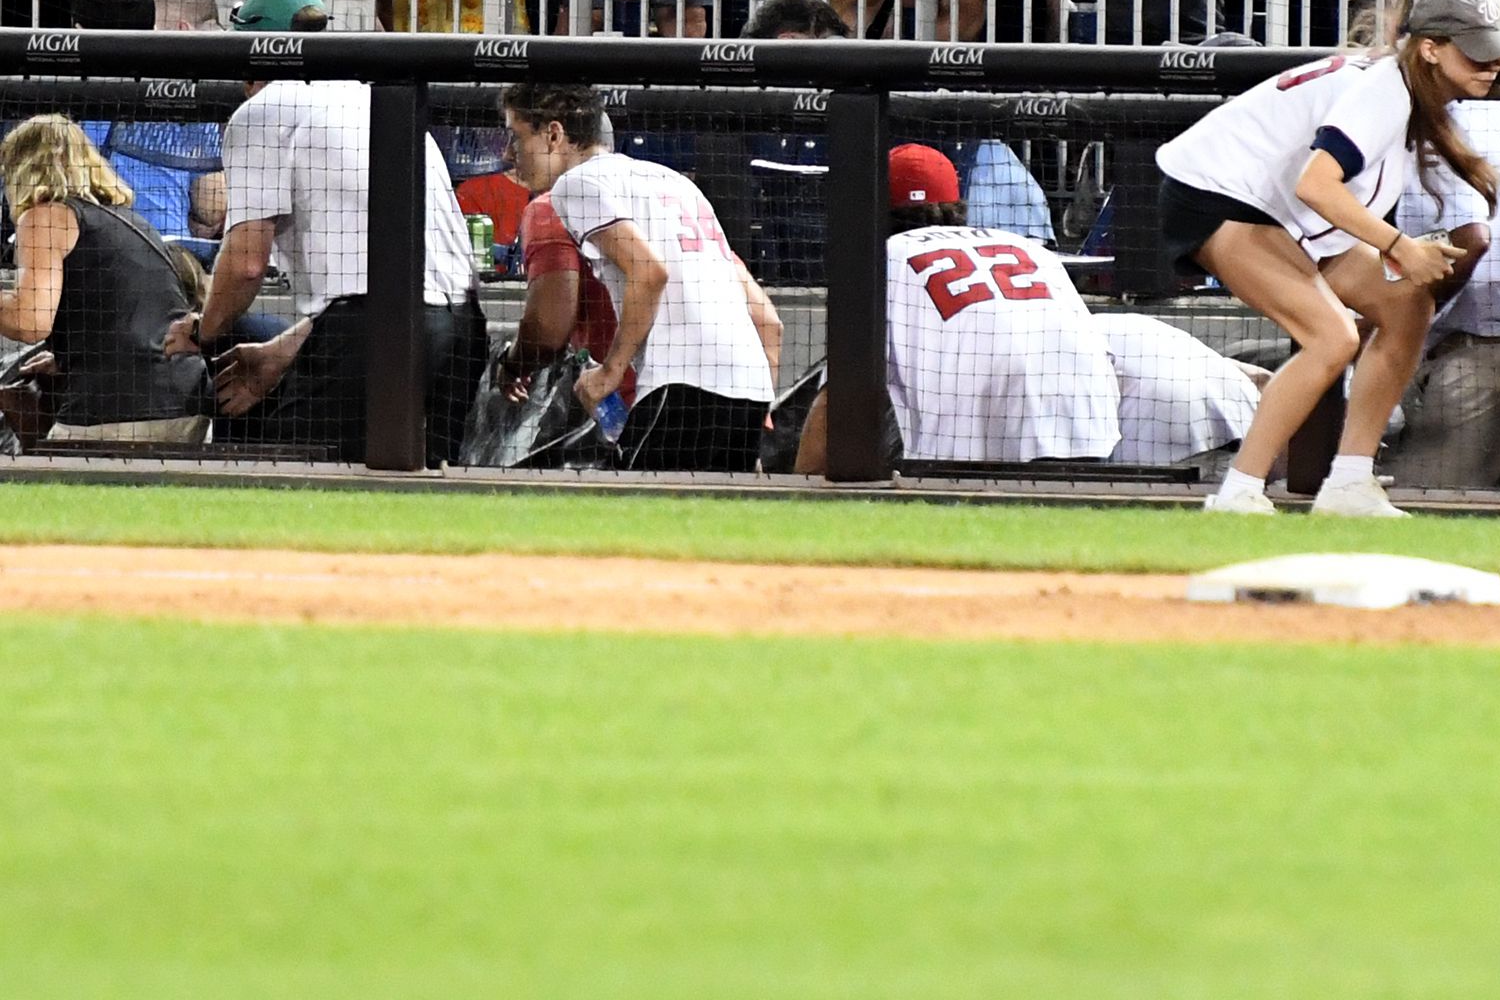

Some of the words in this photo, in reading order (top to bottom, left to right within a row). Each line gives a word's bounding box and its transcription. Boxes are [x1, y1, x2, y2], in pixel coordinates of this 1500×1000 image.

[27, 34, 81, 52] MGM
[250, 37, 304, 55] MGM
[474, 40, 529, 58] MGM
[700, 44, 755, 61] MGM
[928, 47, 984, 65] MGM
[1160, 50, 1216, 69] MGM
[145, 81, 196, 98] MGM
[794, 93, 828, 112] MG
[1014, 99, 1068, 116] MGM
[907, 245, 1053, 322] 22
